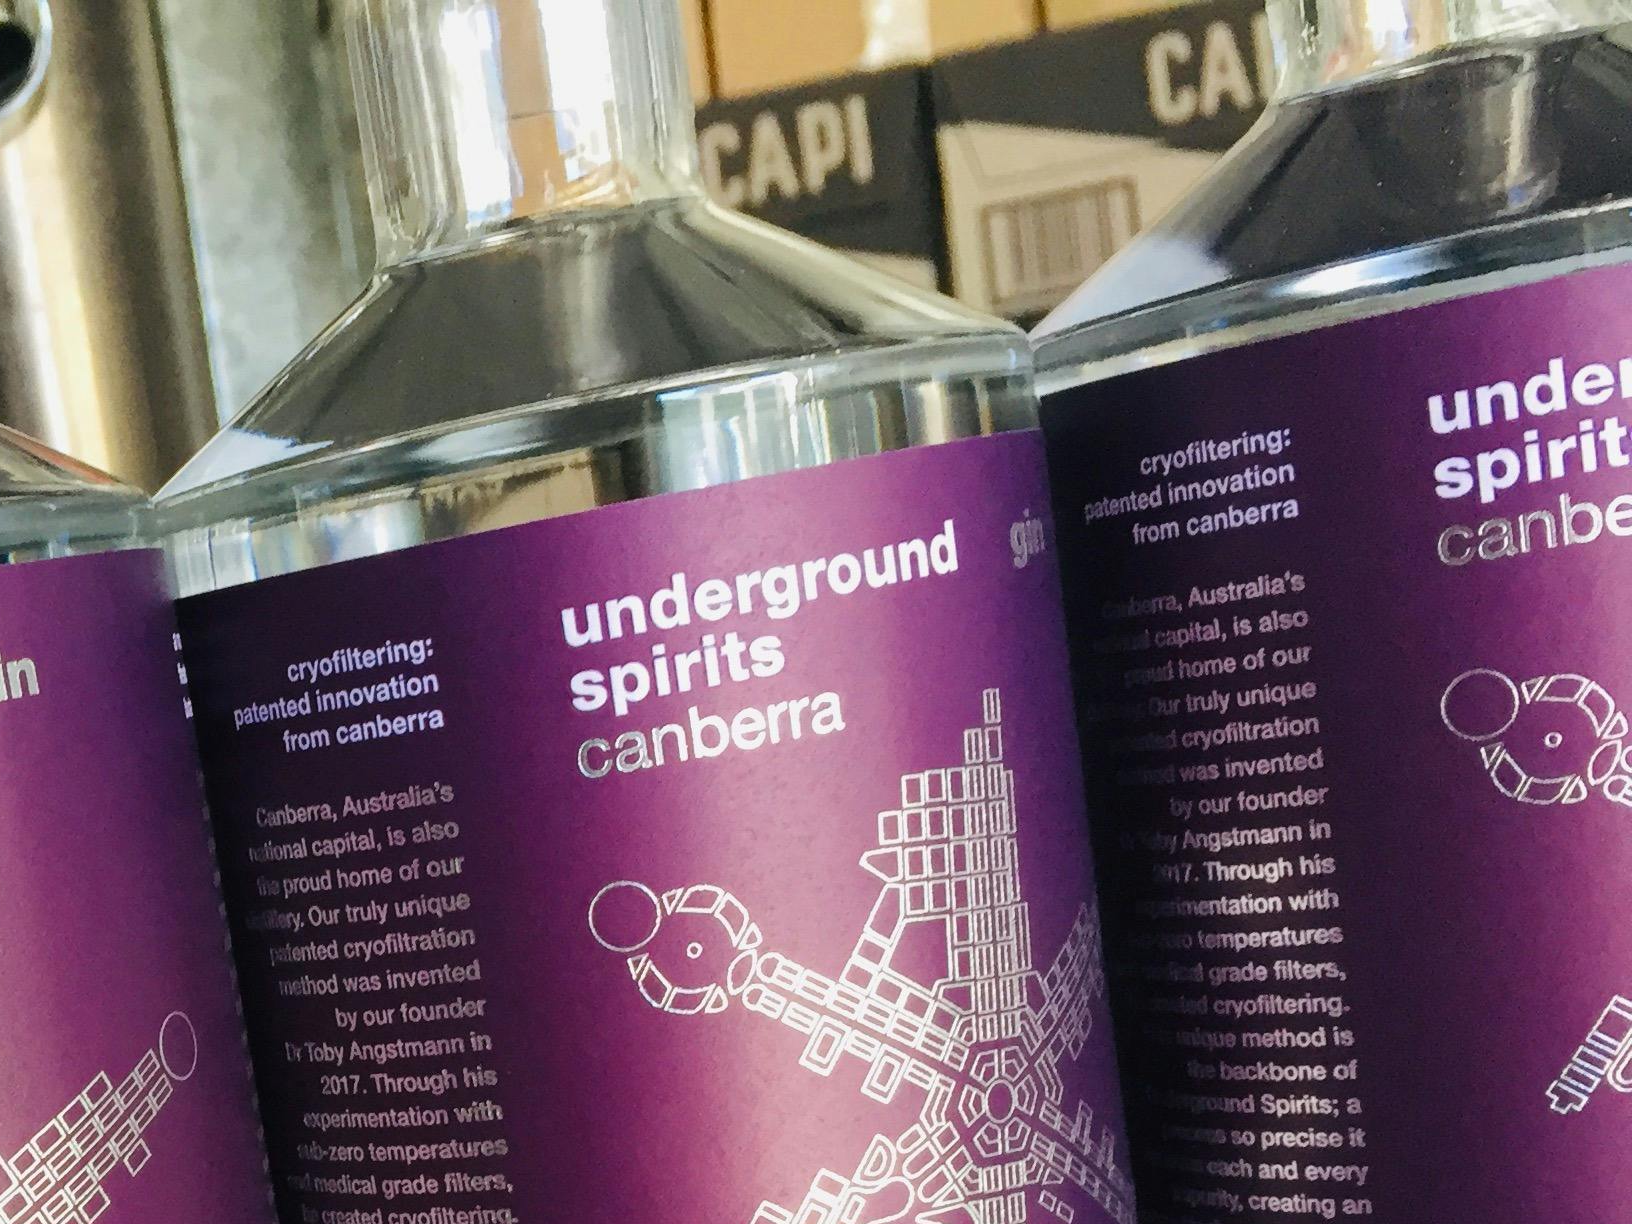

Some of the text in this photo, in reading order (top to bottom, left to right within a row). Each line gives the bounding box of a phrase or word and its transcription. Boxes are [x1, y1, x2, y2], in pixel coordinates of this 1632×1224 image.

[698, 94, 875, 209] CAPI
[1140, 428, 1291, 476] cryofiltering:
[1434, 416, 1632, 504] spirit
[1084, 463, 1295, 524] patented innovation
[1132, 498, 1299, 545] from canberra
[561, 519, 958, 649] underground
[287, 638, 434, 683] cryofiltering:
[570, 632, 785, 717] spirits
[233, 673, 440, 731] patented innovation
[1236, 682, 1317, 707] unique
[282, 709, 445, 752] from canberra
[577, 692, 845, 778] canberra
[1182, 716, 1320, 750] cryofiltration
[1225, 747, 1325, 778] invented
[1237, 785, 1329, 811] founder
[312, 820, 459, 858] capital, is also
[1182, 824, 1302, 852] Angstmann
[284, 856, 465, 898] proud home of our
[1203, 853, 1336, 883] Through his
[308, 905, 340, 927] Our
[345, 900, 388, 925] truly
[394, 892, 470, 919] unique
[1288, 889, 1339, 911] with
[269, 927, 475, 967] patented cryofiltration
[279, 959, 481, 996] method was invented
[1274, 959, 1346, 982] filters,
[335, 997, 487, 1031] by our founder
[304, 1031, 492, 1066] Toby Angstmann in
[1242, 1026, 1327, 1047] method
[370, 1069, 457, 1095] Through
[463, 1065, 498, 1088] his
[303, 1100, 503, 1131] experimentation with
[369, 1138, 509, 1165] temperatures
[1260, 1128, 1343, 1150] precise
[382, 1173, 438, 1200] grade
[444, 1172, 513, 1194] filters,
[1304, 1164, 1368, 1186] every
[1248, 1194, 1336, 1219] creating
